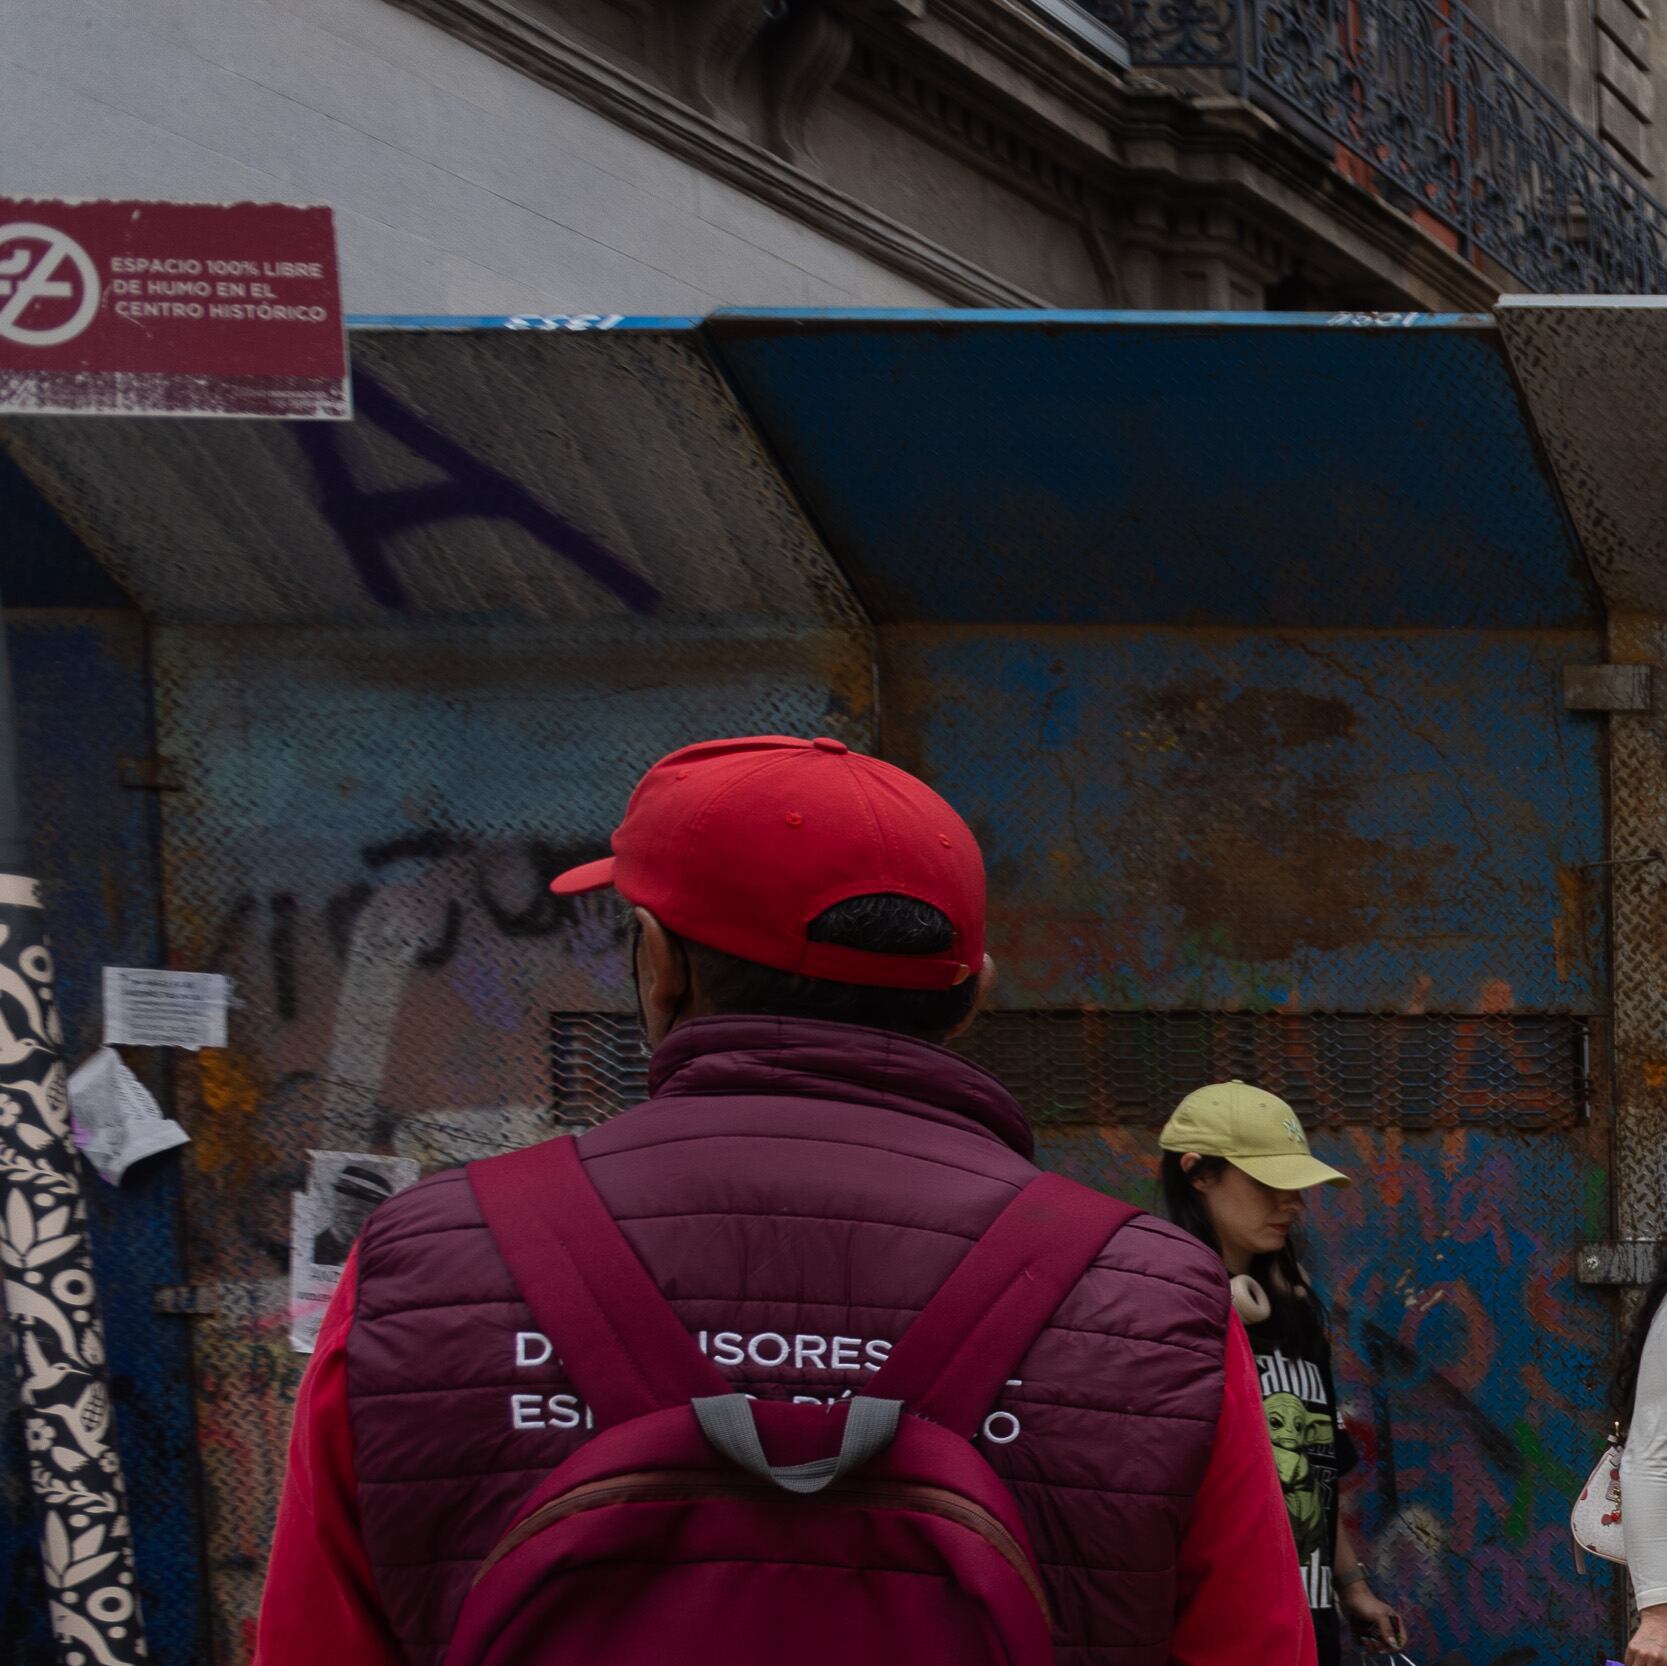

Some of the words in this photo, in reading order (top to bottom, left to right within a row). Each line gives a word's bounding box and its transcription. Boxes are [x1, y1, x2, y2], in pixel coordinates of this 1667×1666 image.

[111, 257, 201, 274] ESPACIO
[206, 260, 260, 276] 100%
[264, 262, 324, 279] LIBRE
[113, 280, 142, 295] DE
[147, 281, 210, 297] HUMO
[216, 282, 246, 298] EN
[250, 283, 277, 299] EL
[115, 301, 204, 319] CENTRO
[209, 301, 327, 323] HISTÓRICO
